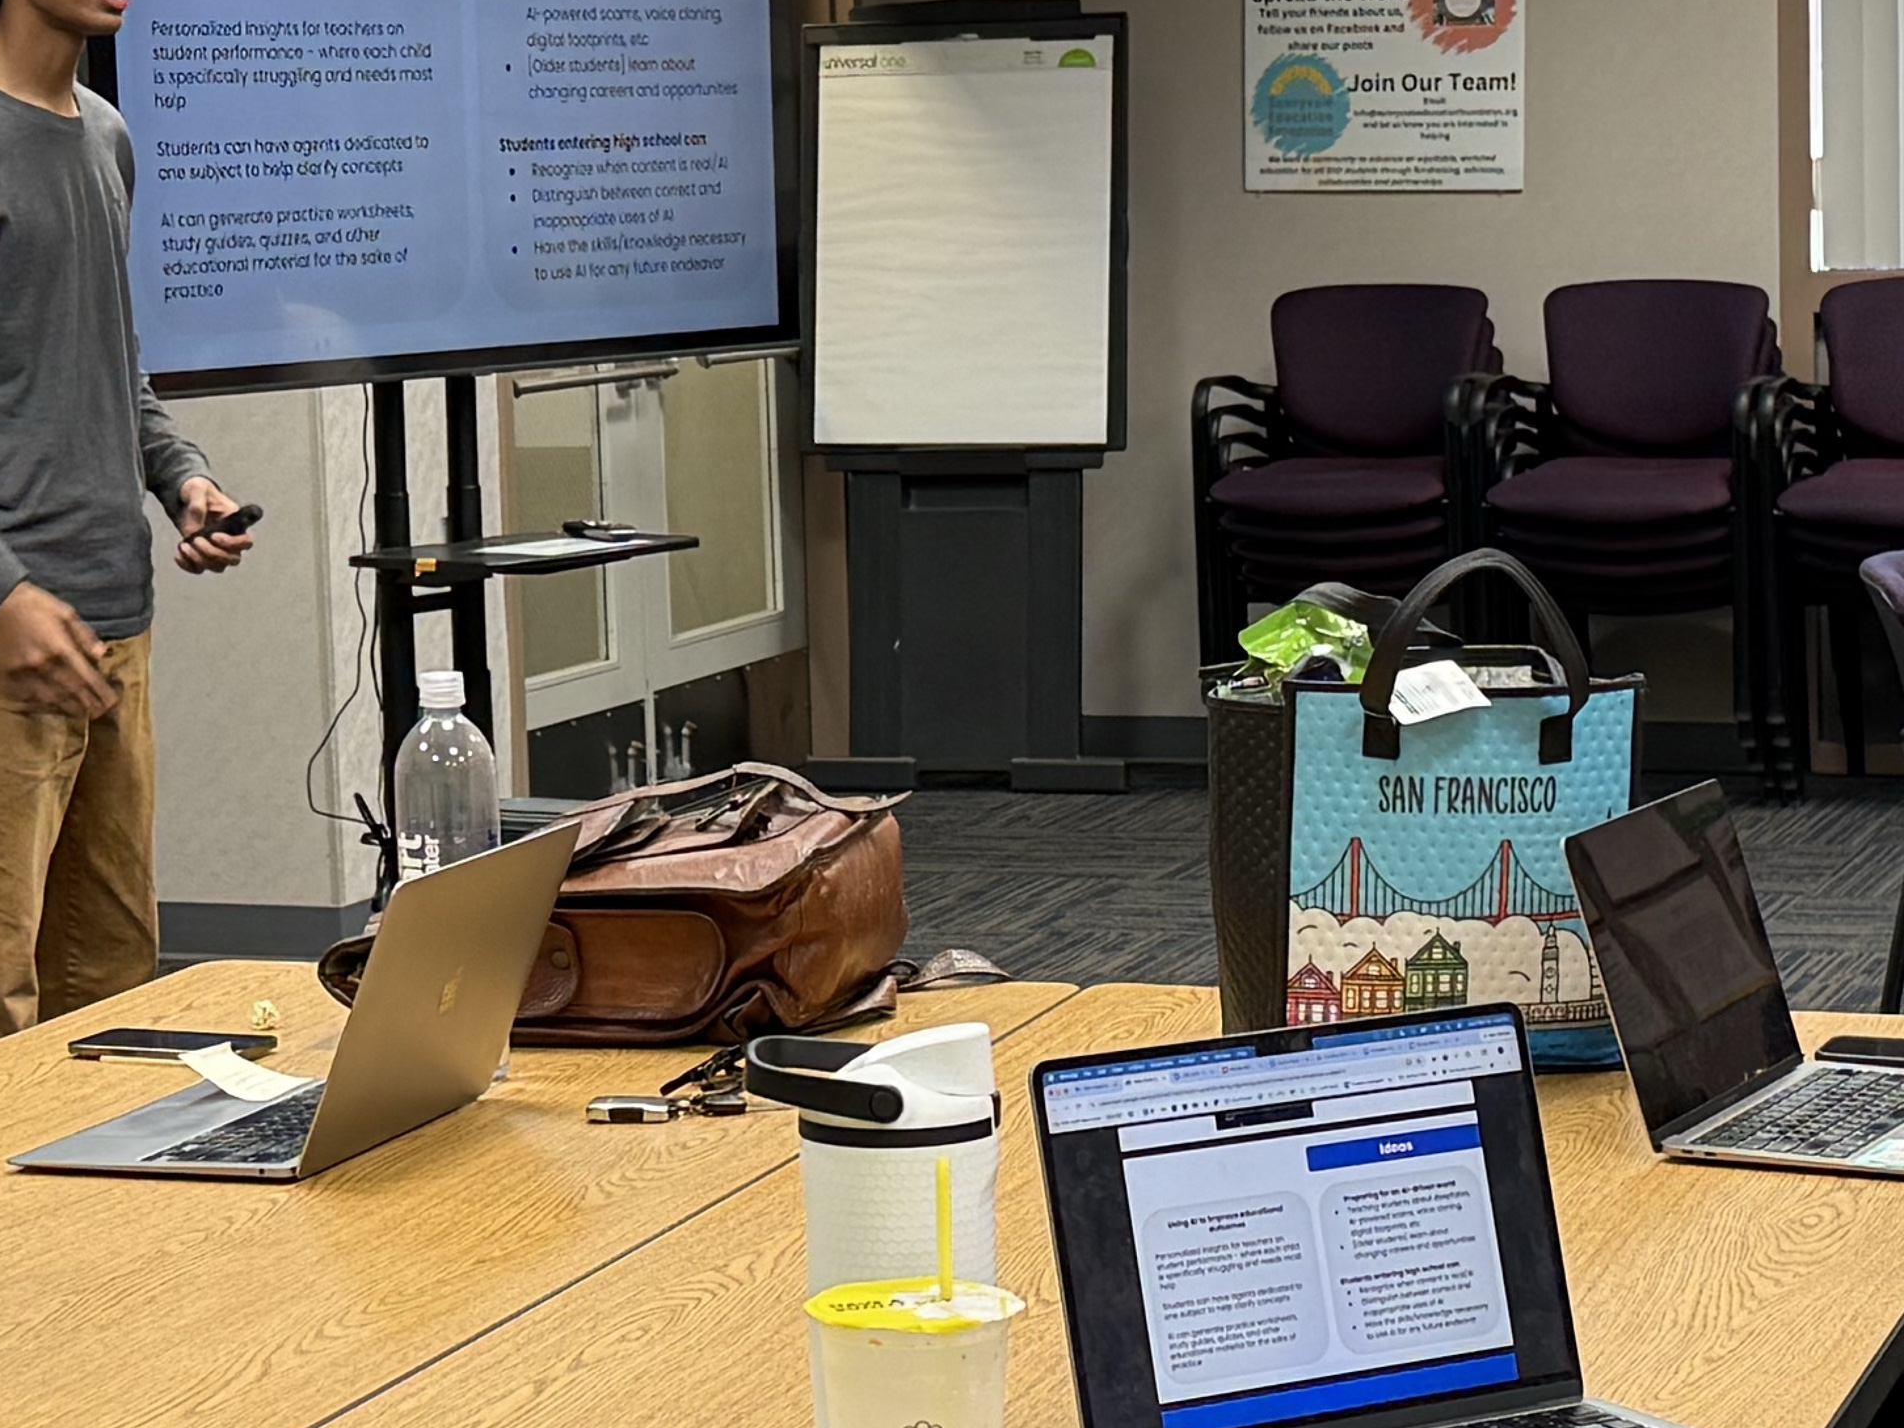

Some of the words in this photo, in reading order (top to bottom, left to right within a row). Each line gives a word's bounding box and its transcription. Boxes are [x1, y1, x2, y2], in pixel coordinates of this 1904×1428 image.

[1259, 8, 1279, 18] Tell
[1282, 9, 1306, 19] your
[1309, 8, 1349, 17] friends
[1352, 8, 1385, 17] about
[152, 20, 241, 37] Personalized
[386, 24, 404, 36] on
[1257, 24, 1291, 34] follow
[1310, 25, 1324, 34] on
[1327, 24, 1380, 34] Facebook
[1383, 24, 1405, 33] and
[152, 45, 208, 61] student
[212, 45, 303, 64] performance
[362, 44, 396, 58] each
[1288, 41, 1318, 51] share
[1321, 42, 1339, 50] our
[1343, 41, 1374, 51] posts
[325, 67, 352, 83] and
[400, 67, 434, 82] most
[1347, 73, 1395, 92] Join
[1402, 73, 1443, 92] Our
[1448, 72, 1516, 91] Team!
[528, 84, 587, 103] changing
[637, 83, 660, 97] and
[156, 140, 220, 157] Students
[223, 142, 251, 155] can
[254, 138, 289, 154] have
[415, 135, 428, 149] to
[499, 137, 555, 153] Students
[558, 136, 611, 153] entering
[613, 134, 640, 153] high
[642, 133, 682, 147] school
[190, 164, 242, 182] subject
[246, 164, 260, 178] to
[342, 159, 404, 176] concepts
[699, 181, 721, 196] and
[178, 214, 205, 227] can
[162, 237, 201, 254] study
[315, 228, 342, 245] and
[1378, 775, 1425, 815] SAN
[1433, 774, 1557, 817] FRANCISCO
[1378, 1140, 1414, 1156] Ideas
